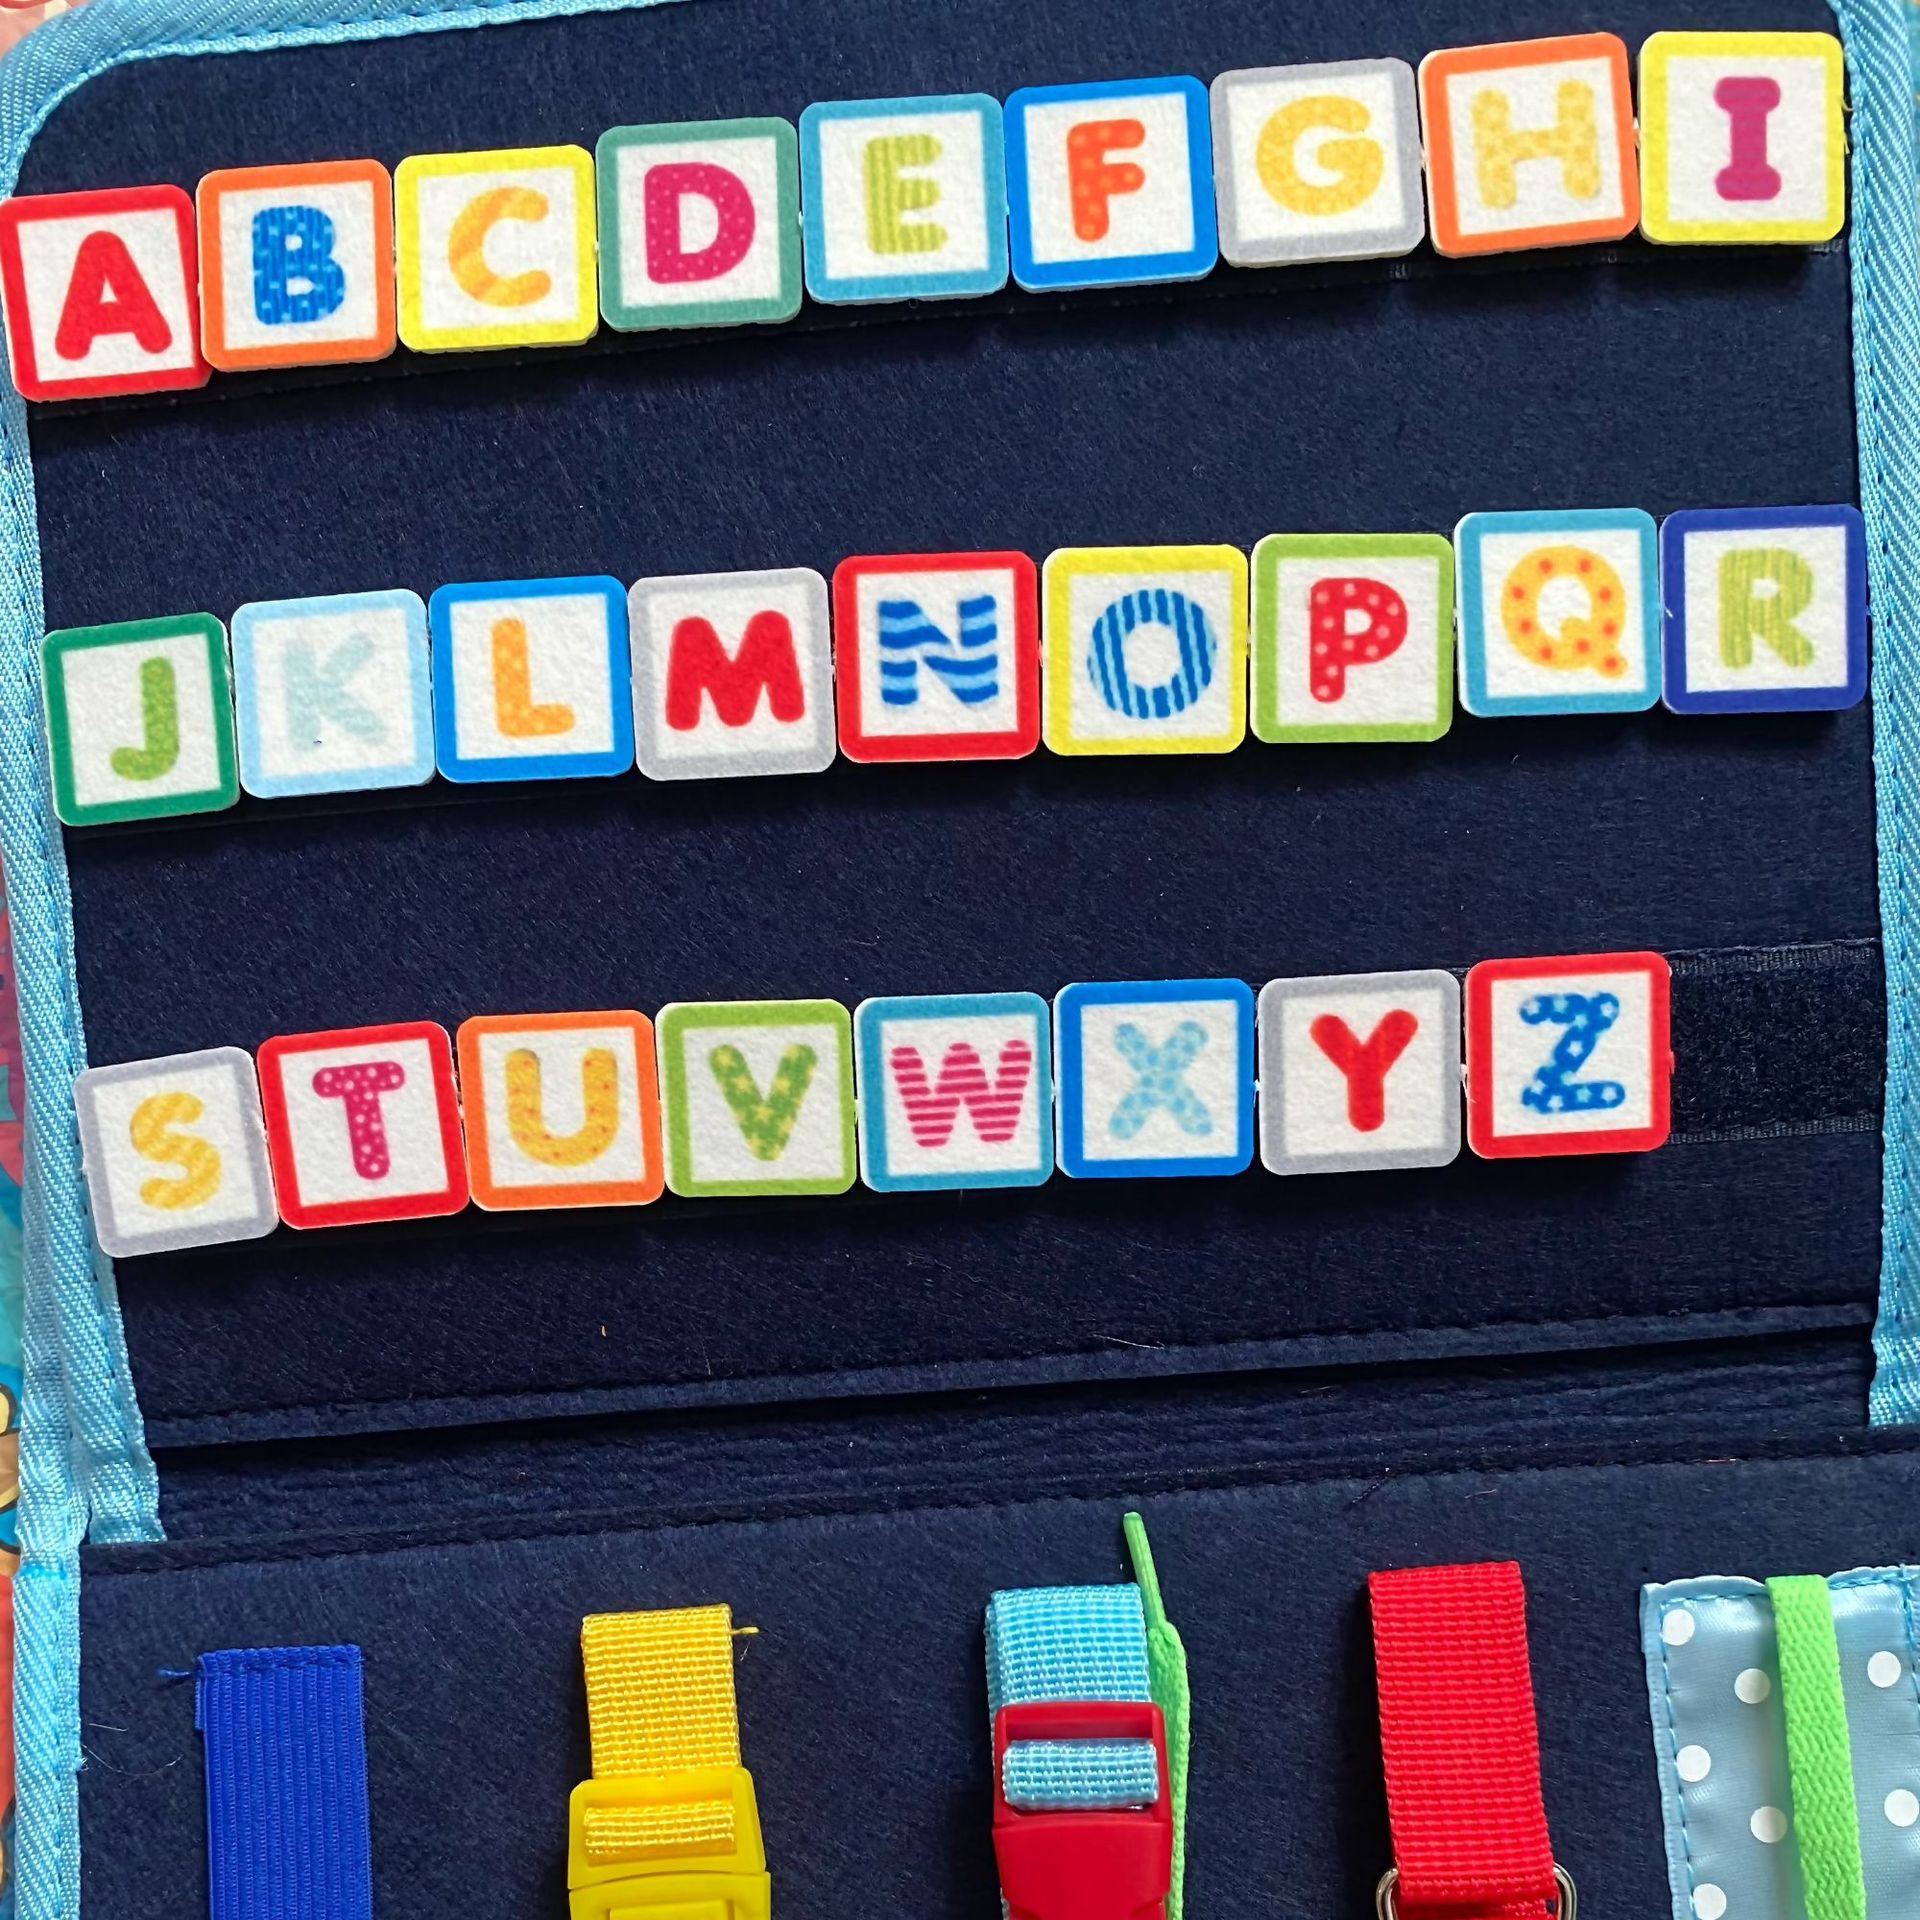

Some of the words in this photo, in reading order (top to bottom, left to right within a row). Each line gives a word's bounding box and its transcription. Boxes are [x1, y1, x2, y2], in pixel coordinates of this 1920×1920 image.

[56, 230, 172, 360] A
[252, 205, 346, 326] B
[448, 188, 551, 308] C
[644, 162, 755, 284] D
[862, 134, 950, 255] E
[1066, 118, 1145, 243] F
[1256, 95, 1384, 216] G
[1472, 80, 1602, 210] H
[1714, 76, 1783, 202] I
[111, 657, 181, 782] J
[282, 634, 380, 756] K
[490, 617, 575, 739] L
[665, 610, 805, 731] M
[880, 595, 996, 706] N
[1086, 588, 1218, 721] O
[1309, 577, 1408, 704] P
[1501, 545, 1628, 678] Q
[1718, 547, 1816, 670] R
[129, 1091, 223, 1210] S
[312, 1061, 406, 1180] T
[506, 1048, 620, 1167] U
[710, 1043, 818, 1162] V
[890, 1039, 1033, 1148] W
[1108, 1020, 1212, 1139] X
[1310, 1008, 1419, 1132] Y
[1520, 991, 1627, 1114] Z
